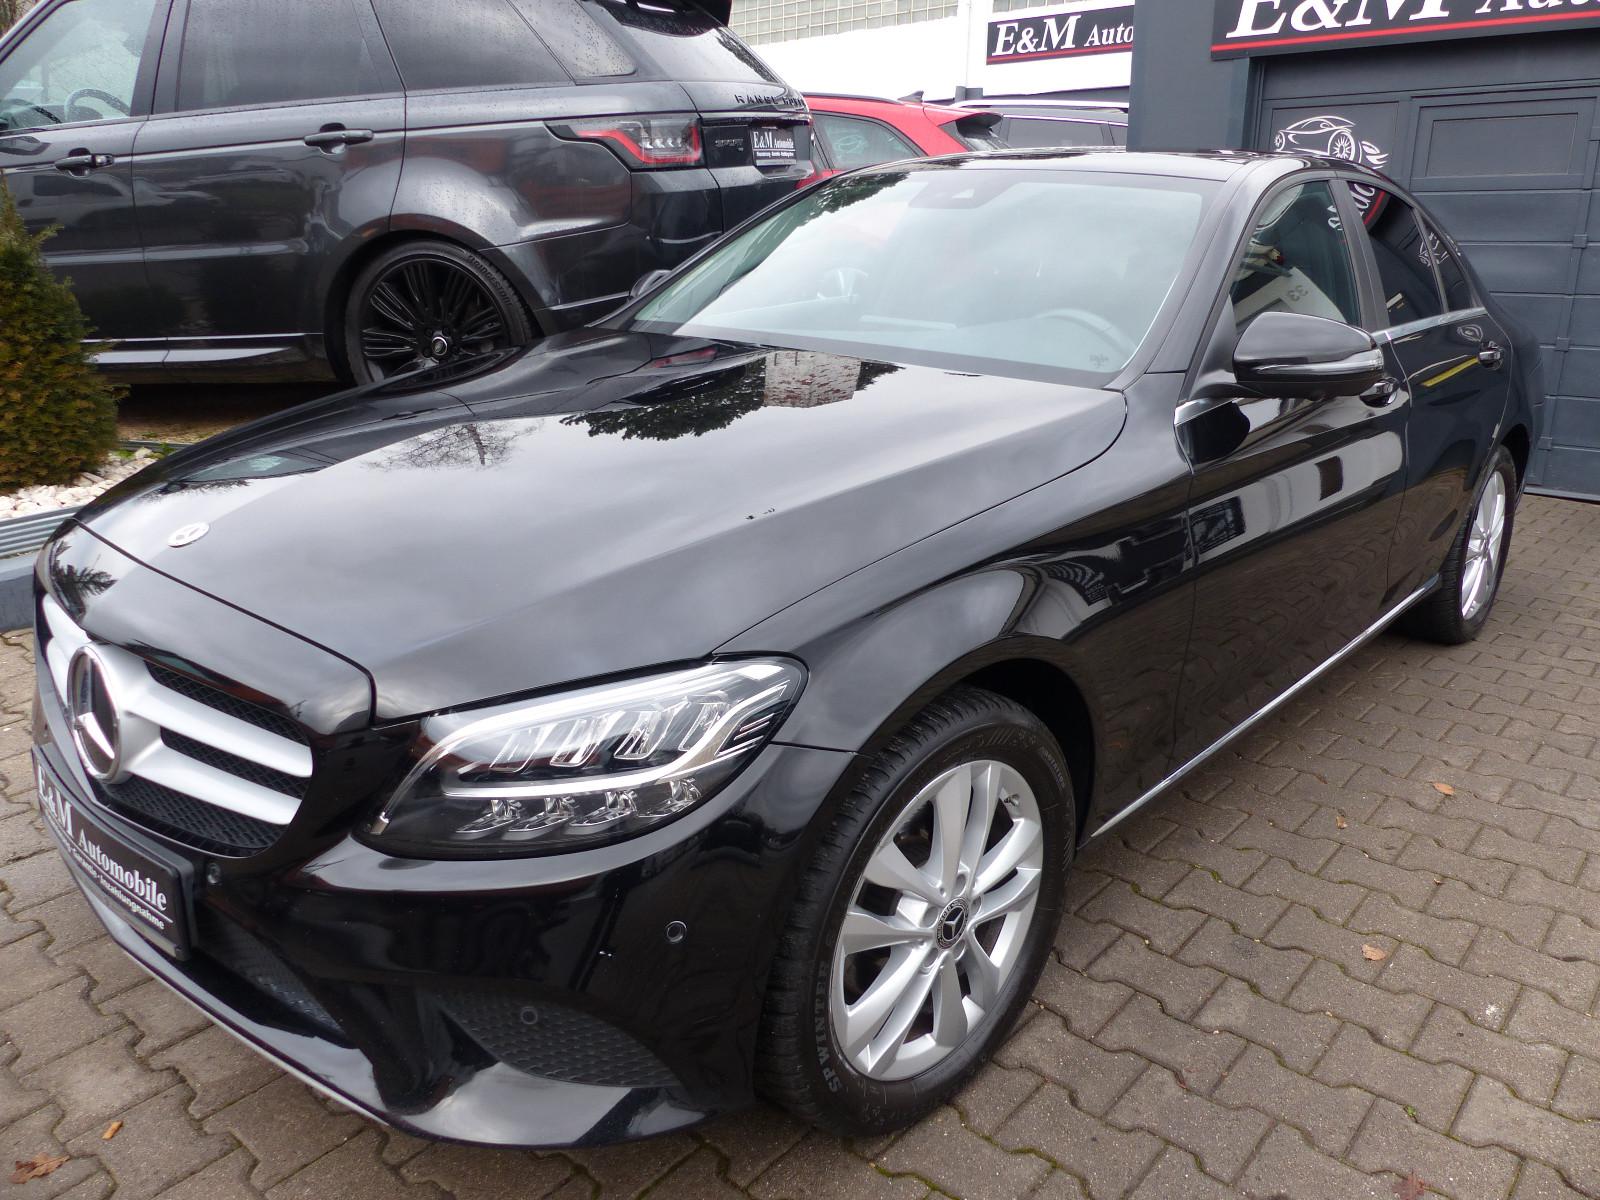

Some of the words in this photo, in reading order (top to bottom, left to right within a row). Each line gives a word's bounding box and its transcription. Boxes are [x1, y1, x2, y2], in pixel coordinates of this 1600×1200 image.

[992, 15, 1082, 57] E&M
[1084, 22, 1133, 47] Auto
[753, 131, 773, 148] E&M
[37, 764, 73, 837] E&M
[78, 828, 167, 911] Automobile
